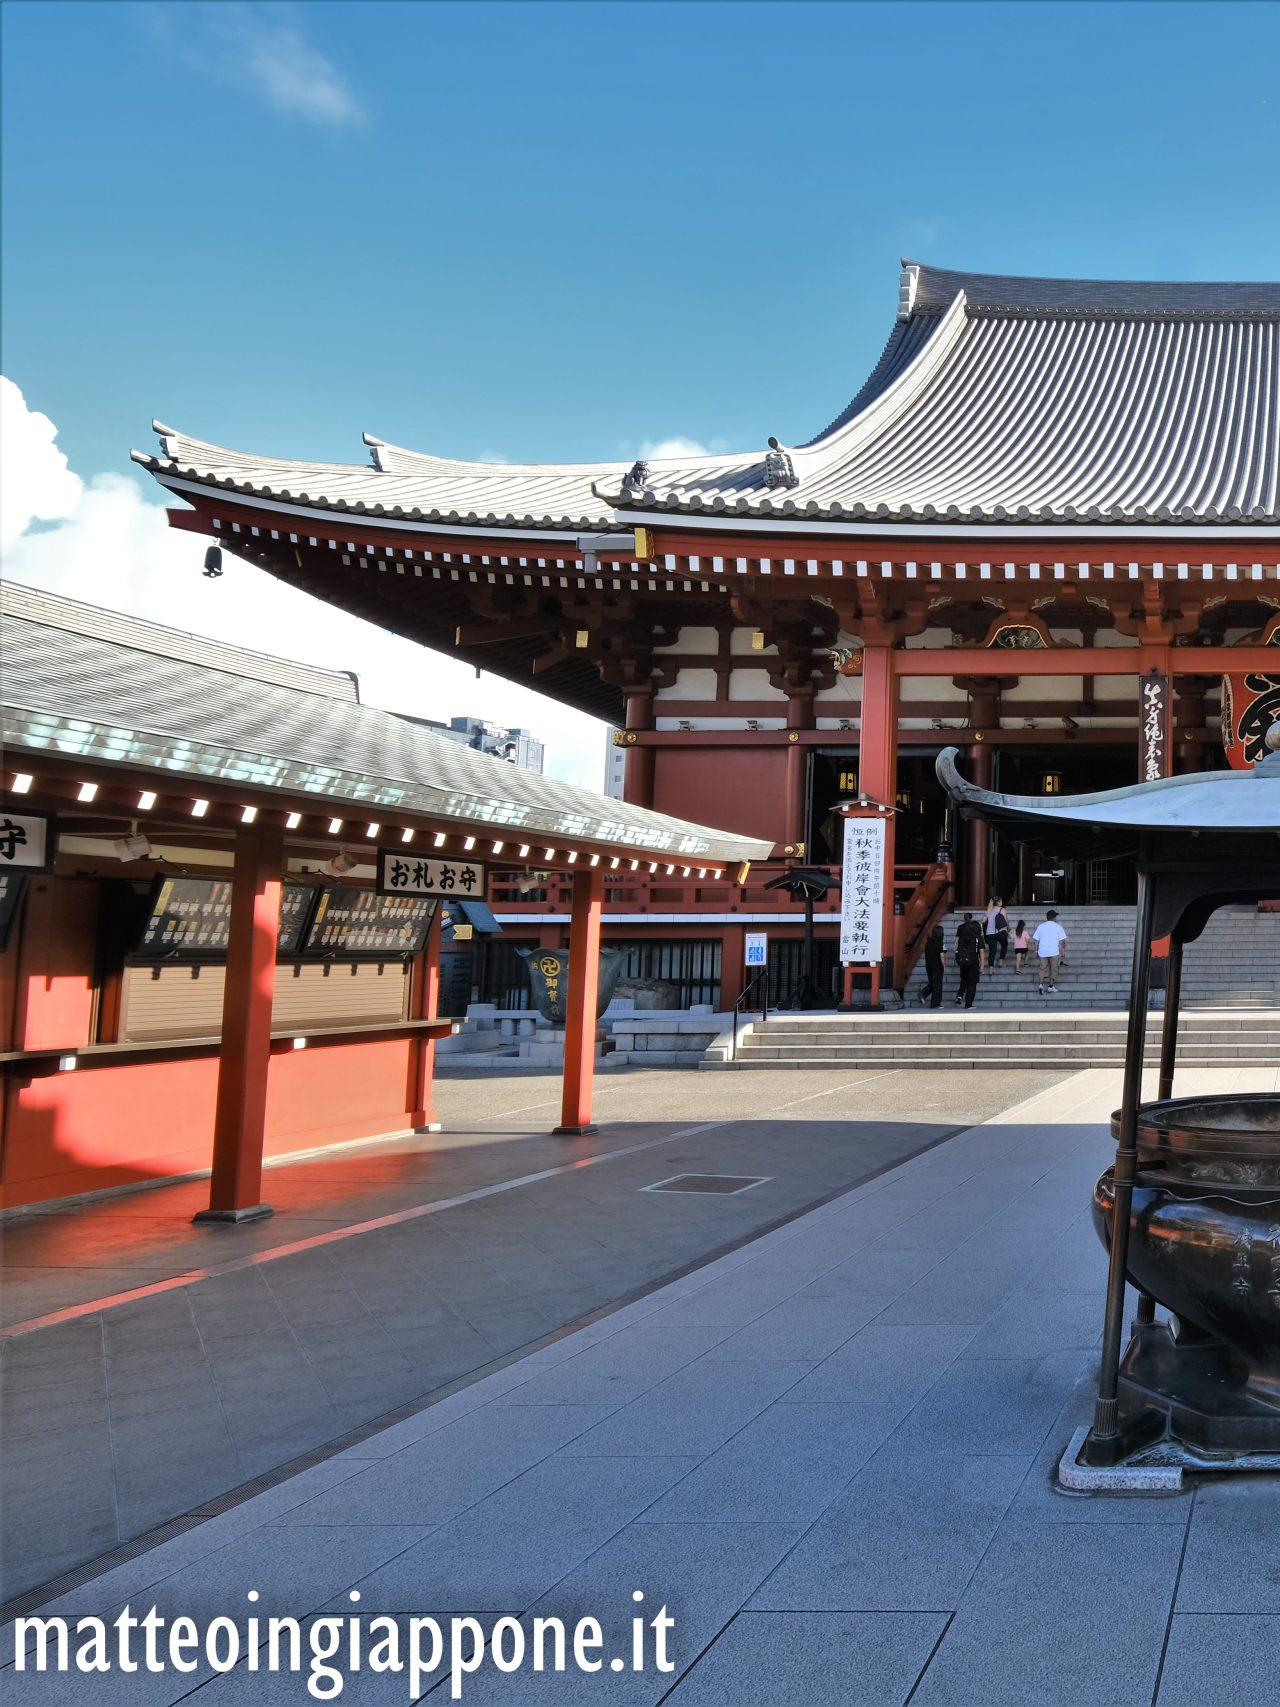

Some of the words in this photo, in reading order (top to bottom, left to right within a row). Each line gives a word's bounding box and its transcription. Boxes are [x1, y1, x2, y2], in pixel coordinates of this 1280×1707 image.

[851, 827, 878, 836] 恒例
[390, 859, 477, 893] お札お守
